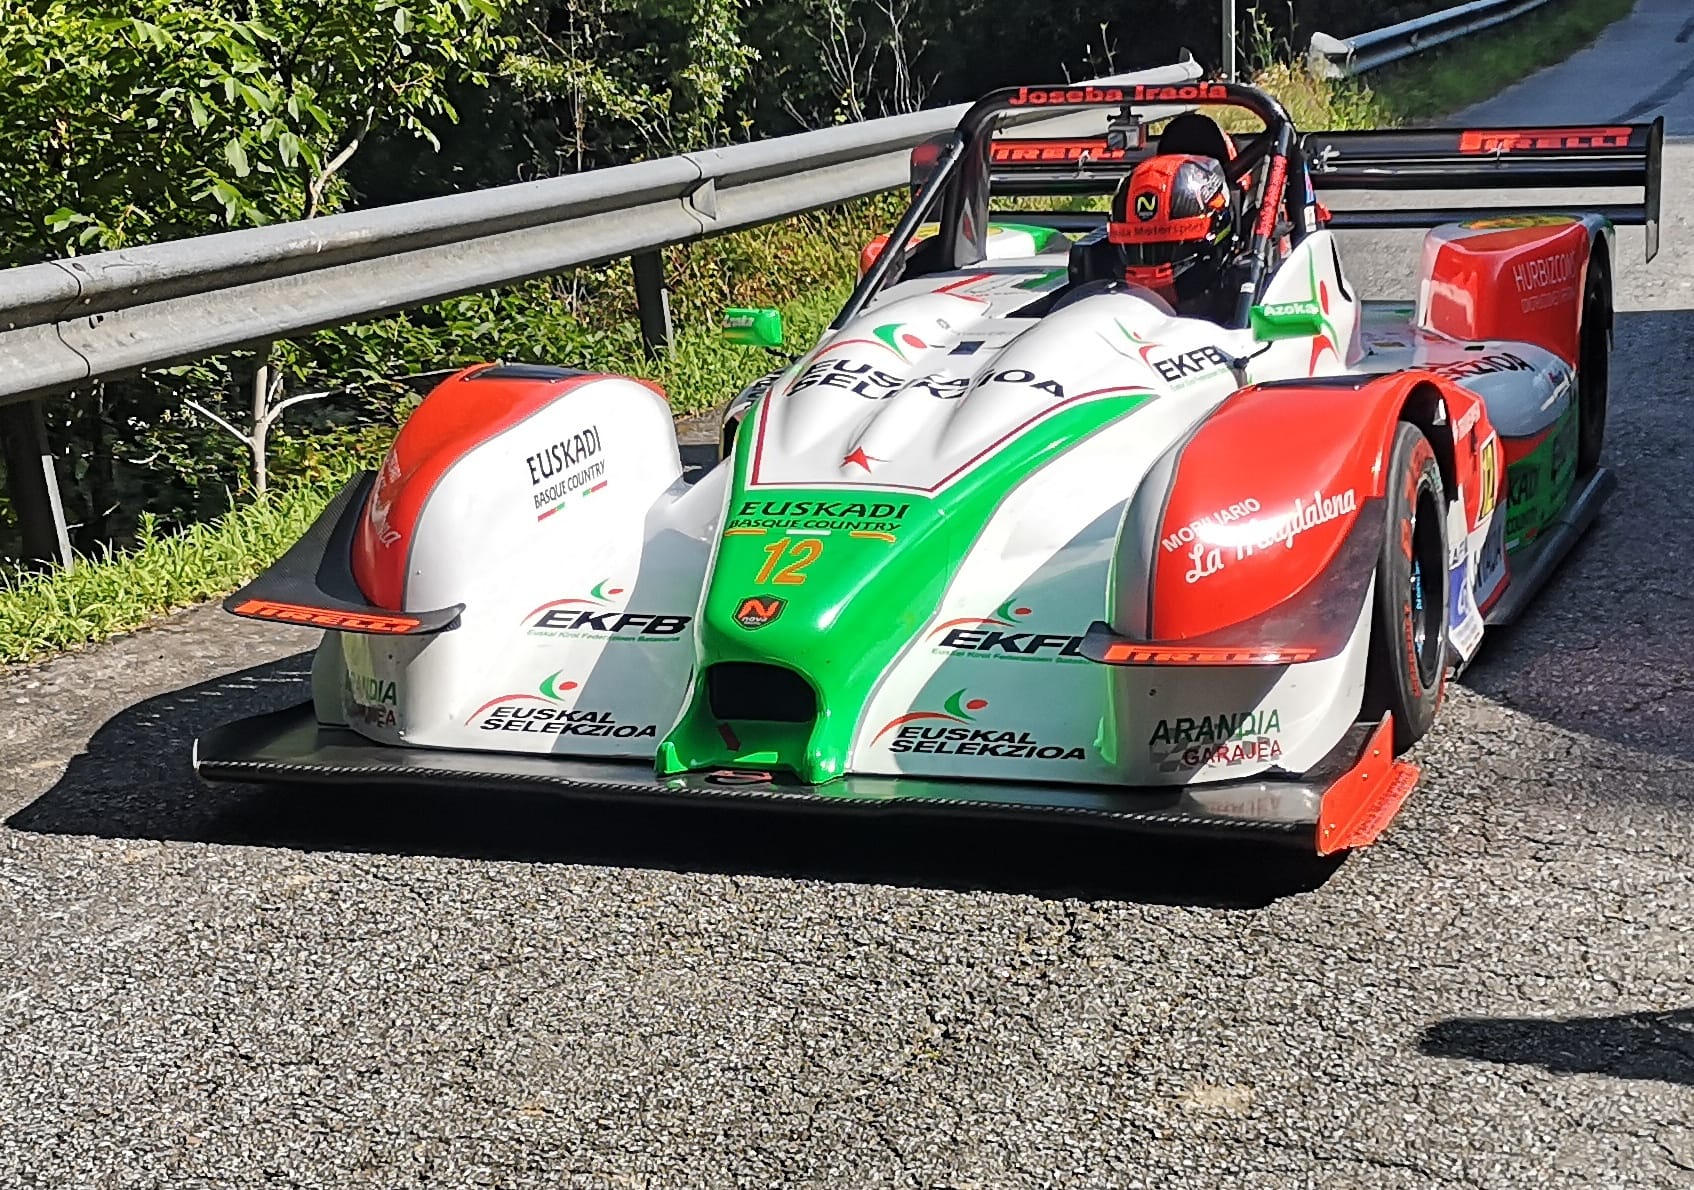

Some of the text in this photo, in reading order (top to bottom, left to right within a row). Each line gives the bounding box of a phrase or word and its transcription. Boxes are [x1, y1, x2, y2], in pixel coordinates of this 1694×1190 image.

[1008, 82, 1228, 105] Joseba Iraola
[990, 141, 1125, 161] IRELLI
[1460, 127, 1633, 153] PIRELLI
[1264, 303, 1320, 317] Azoka
[1153, 345, 1227, 382] EKFB
[526, 425, 601, 486] EUSKADI
[533, 458, 605, 509] BASQUE COUNTRY
[738, 501, 910, 520] EUSKADI
[729, 519, 902, 531] BASQUE COUNTRY
[754, 536, 824, 585] 12
[1185, 543, 1225, 584] La
[233, 600, 420, 633] PIRELLI
[532, 609, 692, 635] EKFB
[1104, 645, 1317, 662] PIRELLI
[491, 706, 616, 724] EUSKAL
[1149, 708, 1281, 746] ARANDIA
[480, 718, 657, 738] SELEKZIOA
[897, 726, 1037, 744] EUSKAL
[888, 740, 1085, 760] SELEKZIOA
[1182, 740, 1283, 766] GARAJEA
